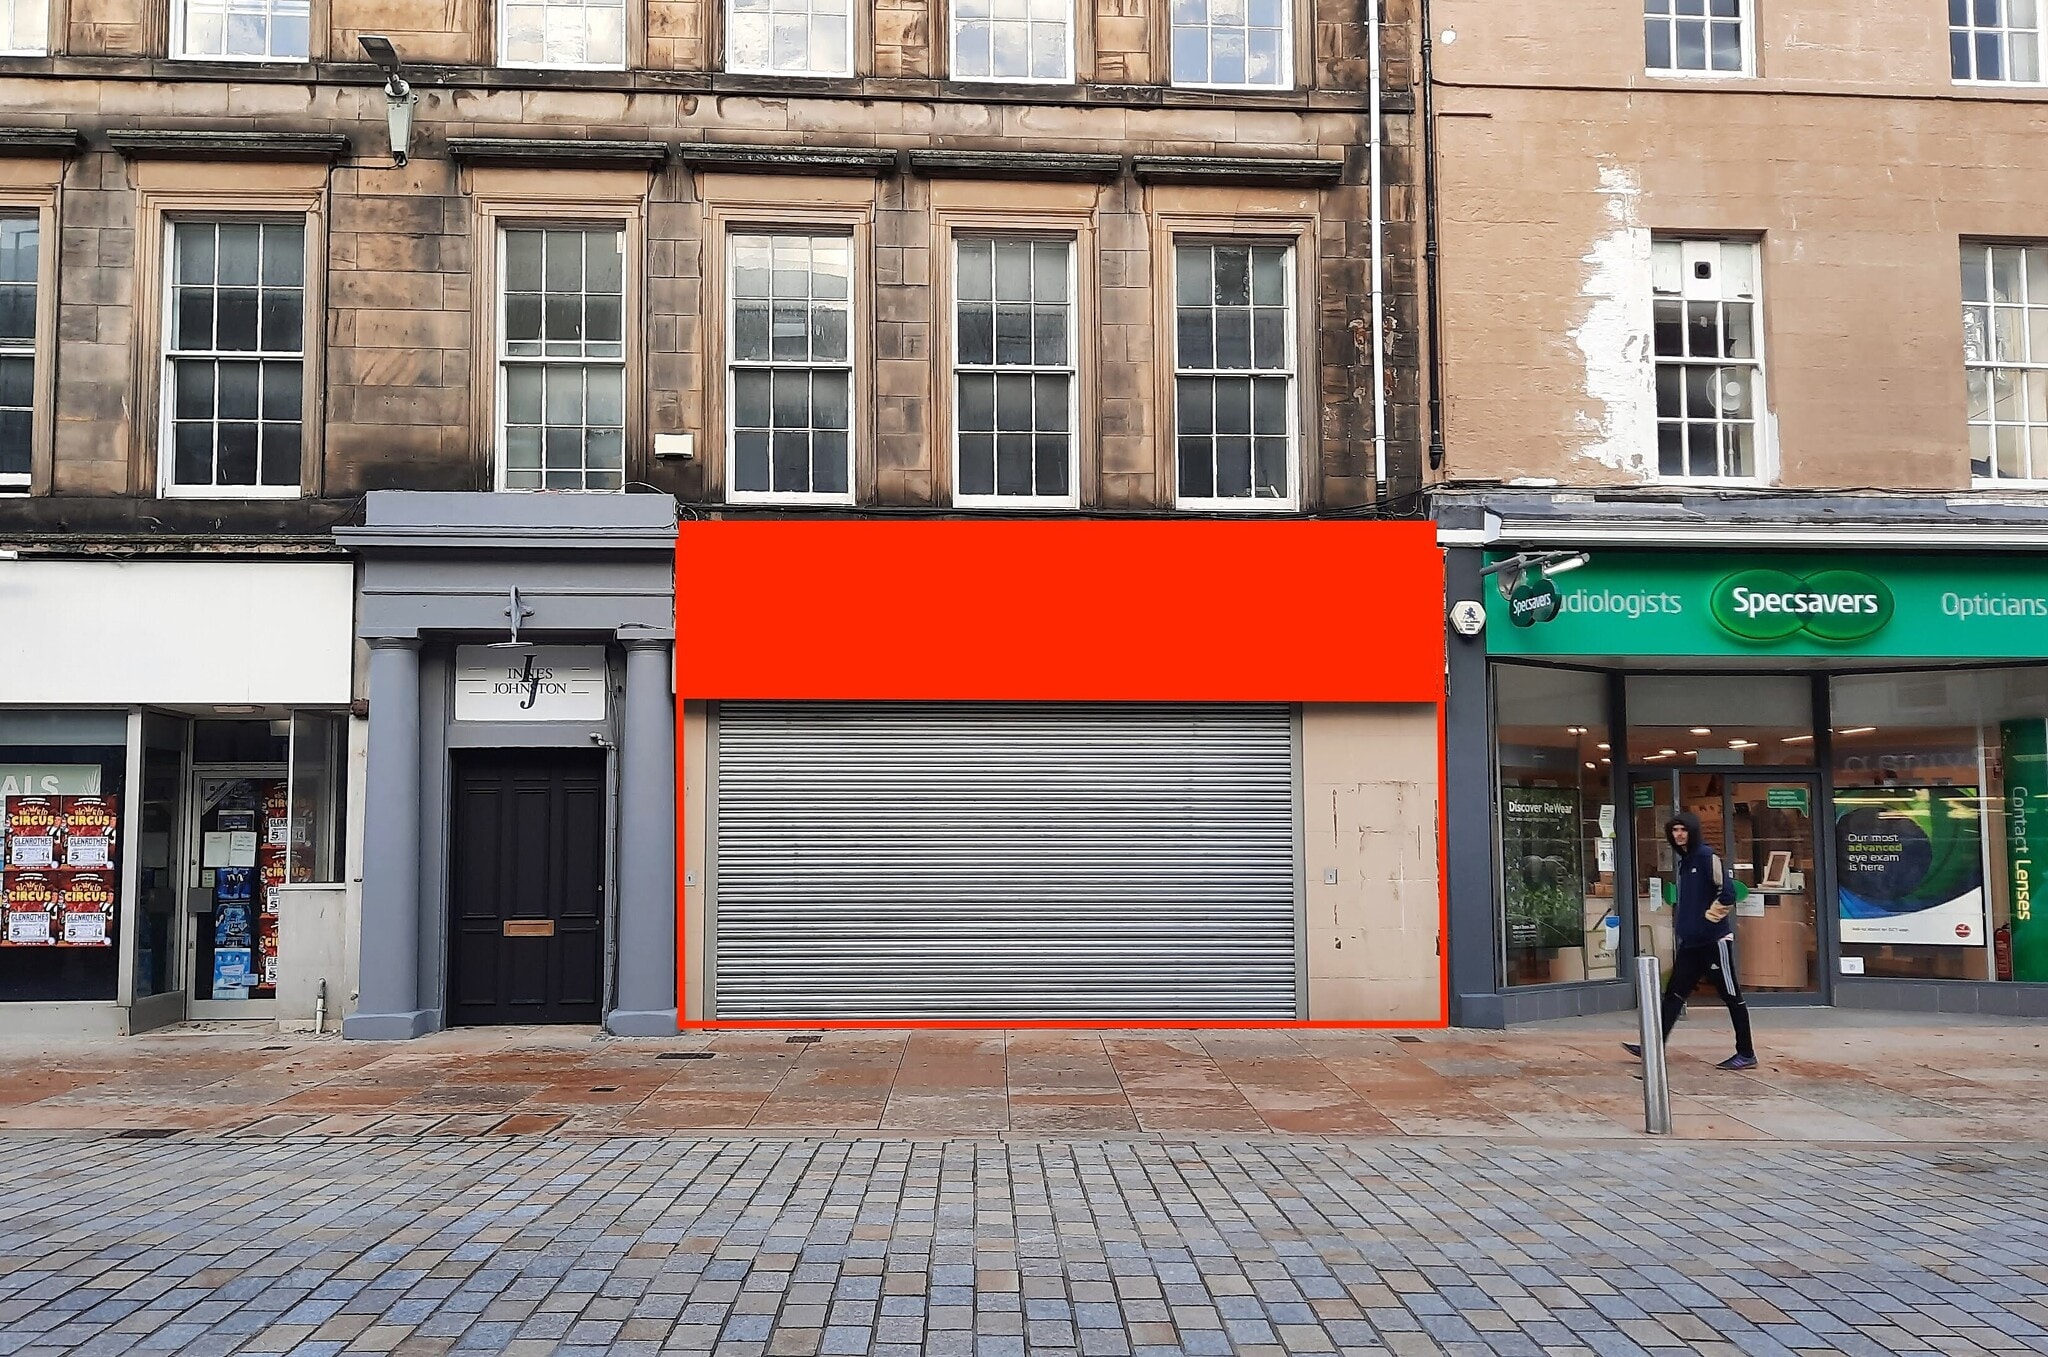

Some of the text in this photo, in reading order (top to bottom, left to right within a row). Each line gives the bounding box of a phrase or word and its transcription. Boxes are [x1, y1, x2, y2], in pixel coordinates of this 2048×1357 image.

[1513, 593, 1551, 616] Specsavers
[1559, 588, 1682, 619] udiologists
[1733, 587, 1878, 618] Specsavers
[1942, 591, 2047, 620] Opticians
[492, 682, 567, 694] JOHNTON
[1508, 801, 1542, 812] Discover
[11, 815, 54, 826] CIRCUS
[67, 815, 110, 826] CIRCUS
[1848, 834, 1868, 842] Our
[1848, 843, 1902, 852] advanced
[2012, 786, 2032, 920] Contact Lenses
[1849, 854, 1900, 863] eye exam
[266, 867, 306, 877] CIRUS
[1849, 863, 1885, 872] is here
[8, 891, 51, 902] CIRCUS
[64, 891, 107, 902] CIRCUS
